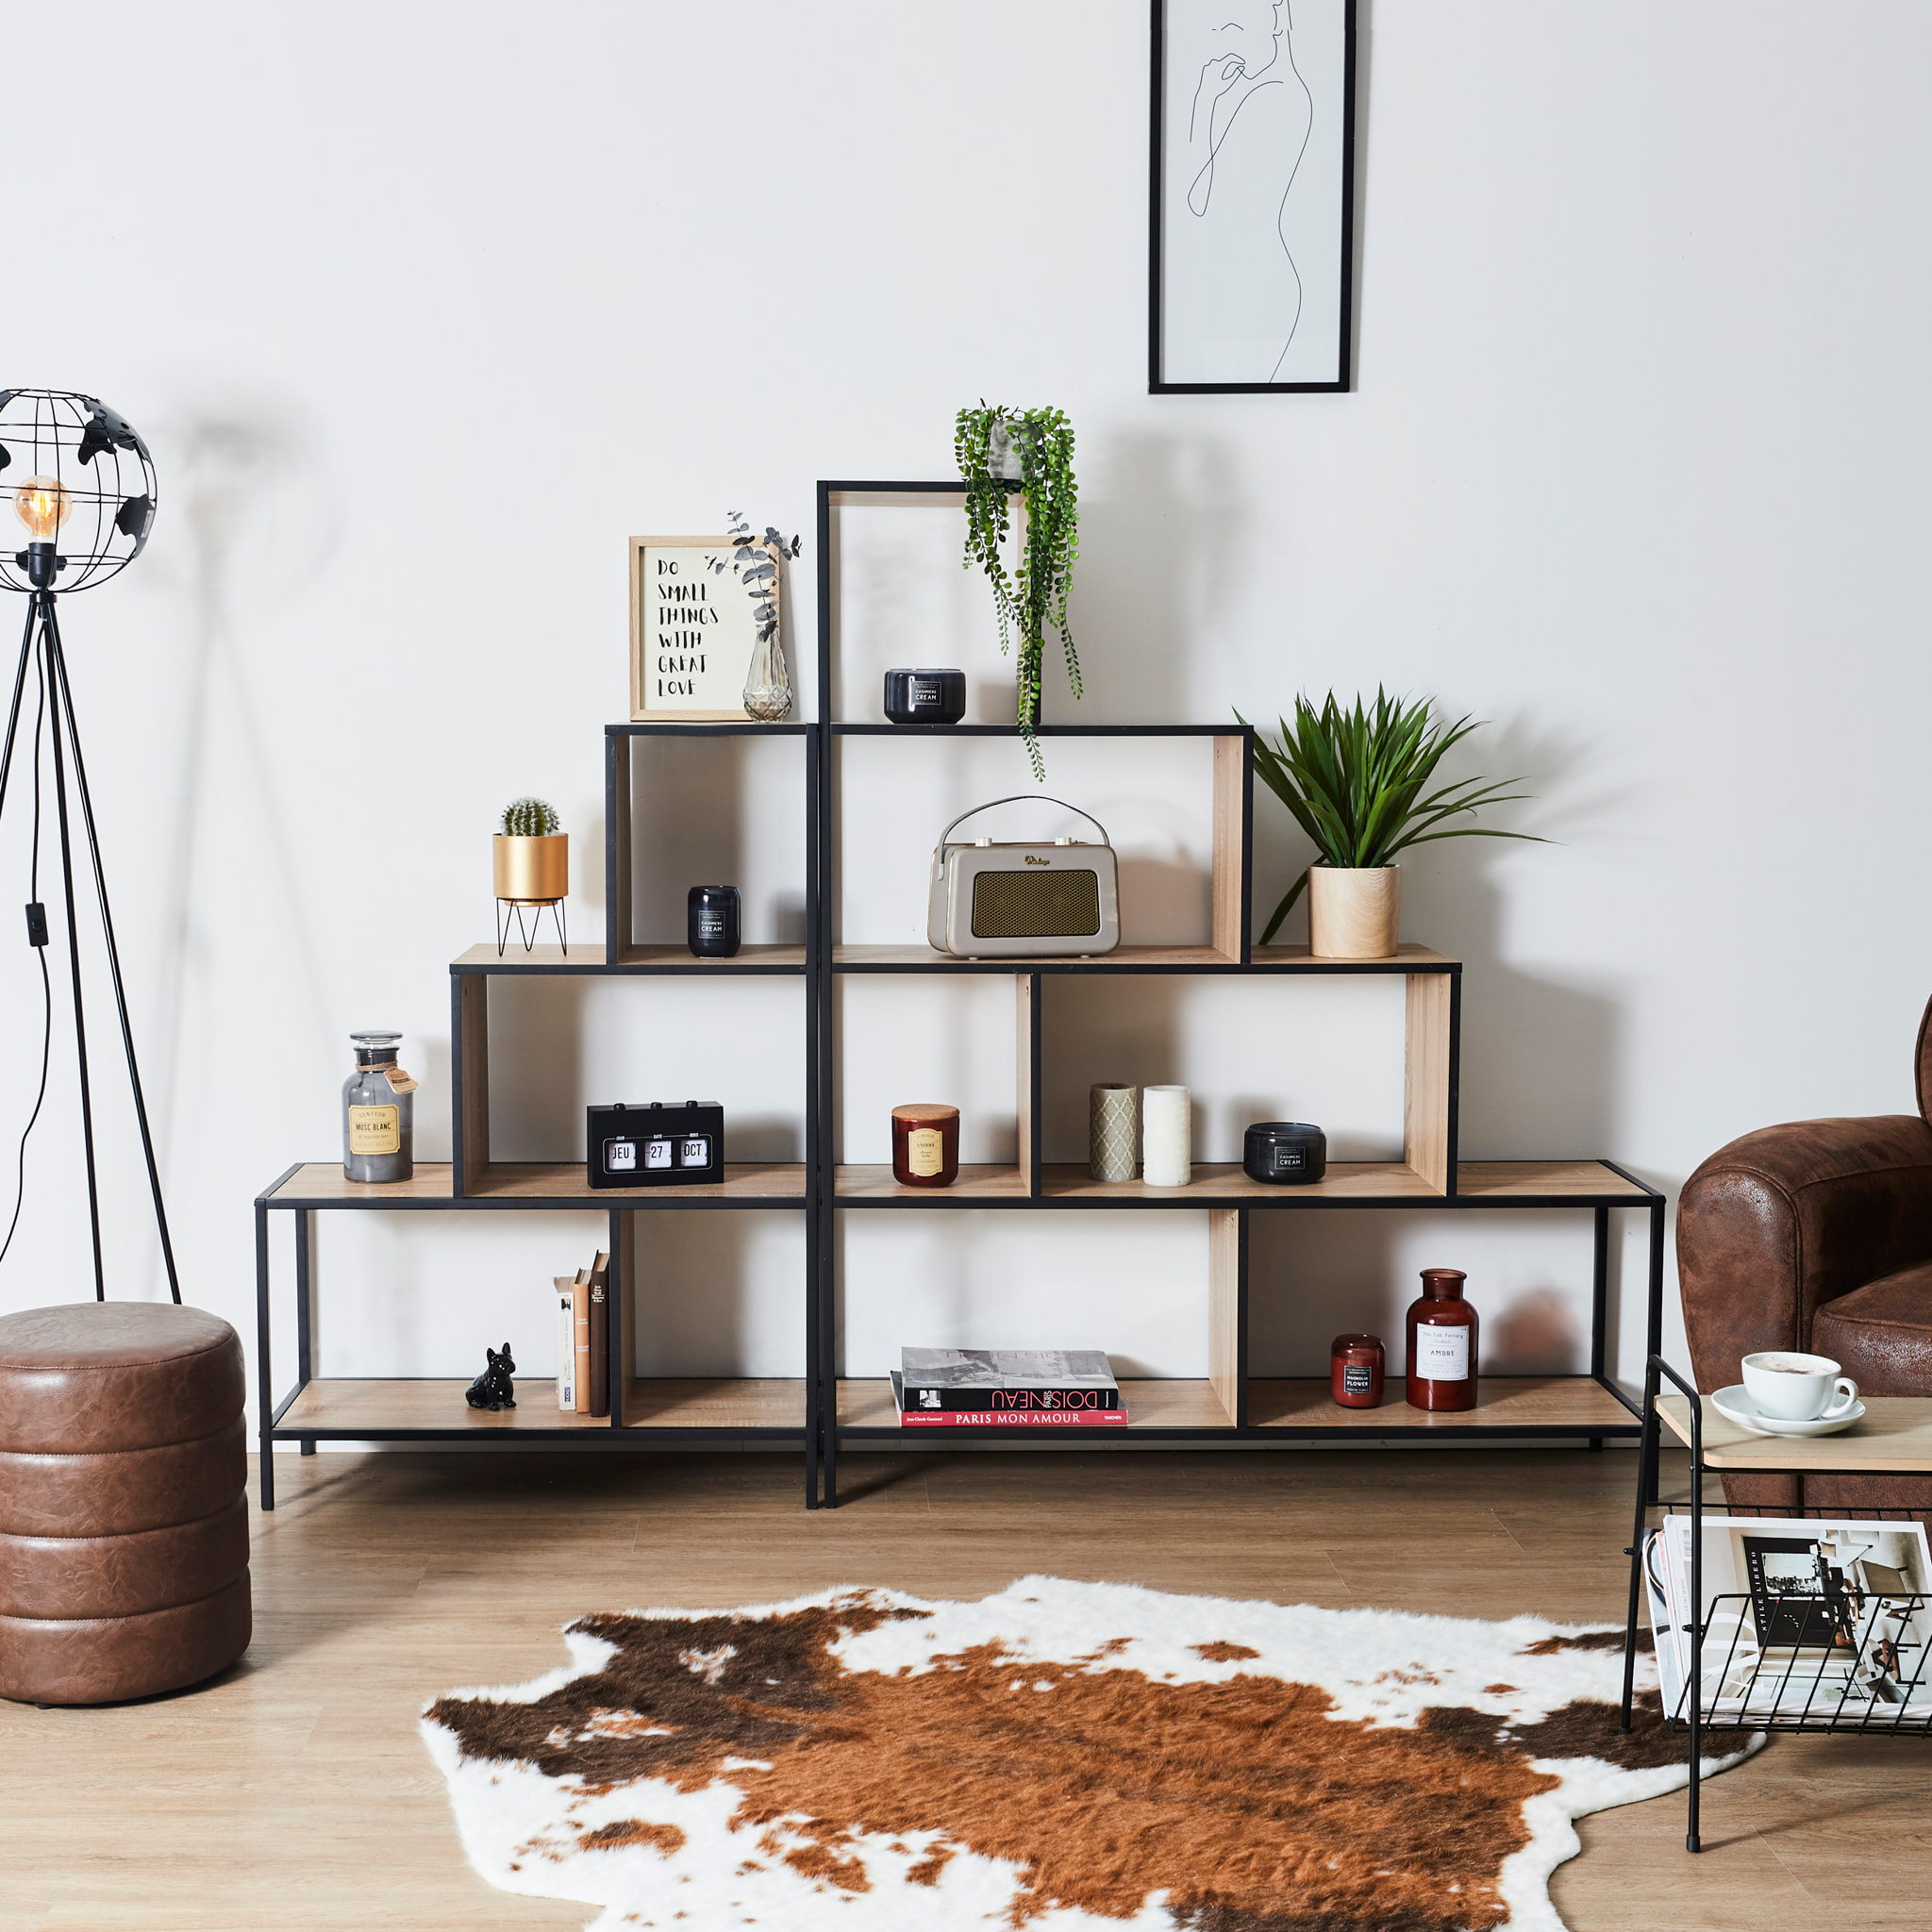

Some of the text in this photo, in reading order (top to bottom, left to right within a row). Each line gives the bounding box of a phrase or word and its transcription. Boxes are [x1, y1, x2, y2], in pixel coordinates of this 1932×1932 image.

[658, 558, 678, 575] DO
[658, 583, 709, 602] SMALL
[658, 607, 719, 625] THINGS
[658, 630, 702, 649] WITH
[658, 655, 708, 674] GREAT
[658, 678, 696, 696] LOVE
[612, 1143, 702, 1159] JEU 27 OCT
[991, 1391, 1097, 1408] DOISNEAU
[1044, 1391, 1053, 1408] PARIS
[956, 1414, 991, 1424] PARIS
[997, 1413, 1027, 1424] MON
[1032, 1413, 1081, 1424] AMOUR
